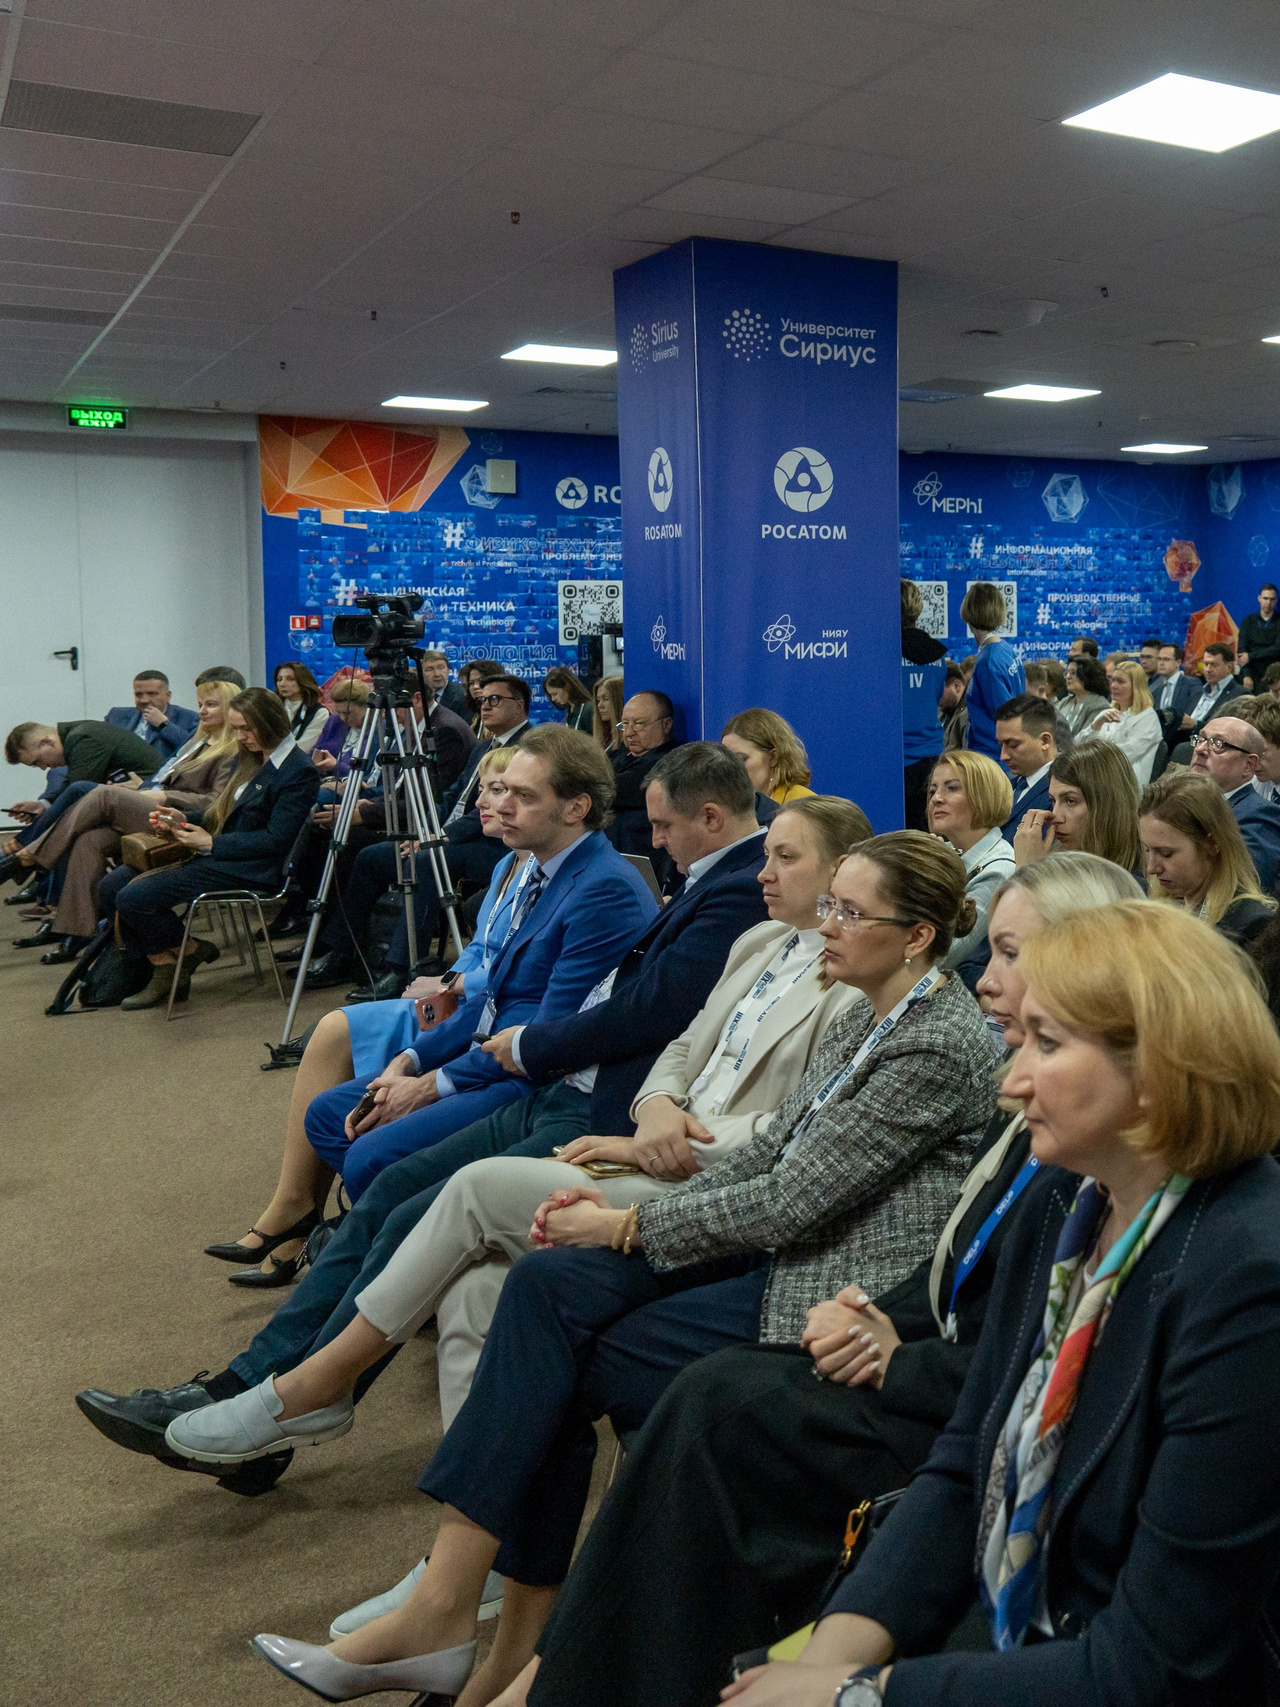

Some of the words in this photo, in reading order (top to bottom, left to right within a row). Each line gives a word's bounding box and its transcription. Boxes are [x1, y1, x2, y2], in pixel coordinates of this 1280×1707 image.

[651, 319, 679, 346] Sirius
[780, 317, 876, 340] Университет
[652, 344, 679, 363] University
[780, 334, 877, 368] Сириус
[71, 409, 123, 422] ВЫХОД
[932, 498, 983, 514] MEPhI
[644, 523, 682, 541] ROSATOM
[761, 524, 847, 540] РОСАТОМ
[541, 552, 598, 561] ПРОБЛЕМЫ
[995, 544, 1093, 556] ИНФОРМАЦИОННАЯ
[1048, 593, 1141, 602] ПРОИЗВОДСТВЕННЫЕ
[451, 601, 515, 612] ТЕХНИКА
[467, 618, 515, 628] Technology
[822, 629, 849, 638] НИЯУ
[784, 641, 848, 660] МИФИ
[909, 672, 924, 689] IV
